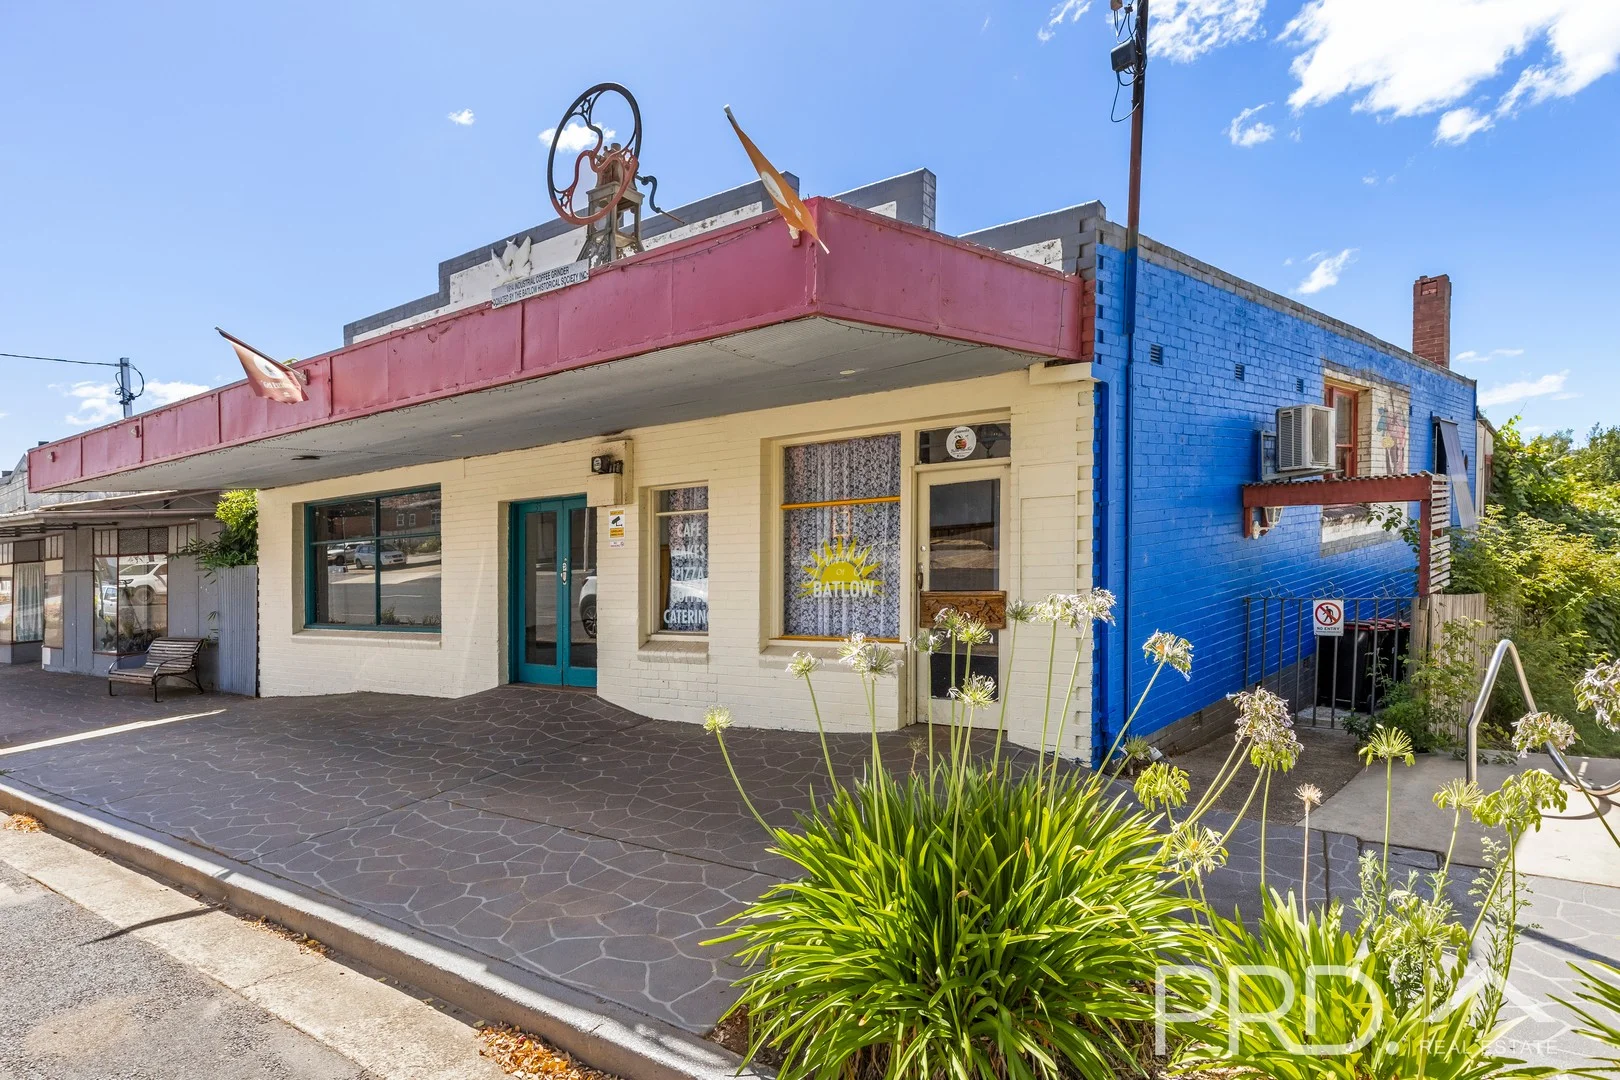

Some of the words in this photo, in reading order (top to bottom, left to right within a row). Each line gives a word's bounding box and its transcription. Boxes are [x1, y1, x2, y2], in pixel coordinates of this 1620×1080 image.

[535, 271, 551, 284] COFFEE
[550, 266, 570, 279] GRINDER
[514, 290, 522, 299] THE
[521, 285, 538, 297] BATLOW
[537, 278, 561, 292] HISTORICAL
[560, 273, 579, 286] SOCIETY
[676, 522, 702, 537] CAFE
[674, 566, 704, 581] PIZZA
[813, 580, 875, 598] BATLOW
